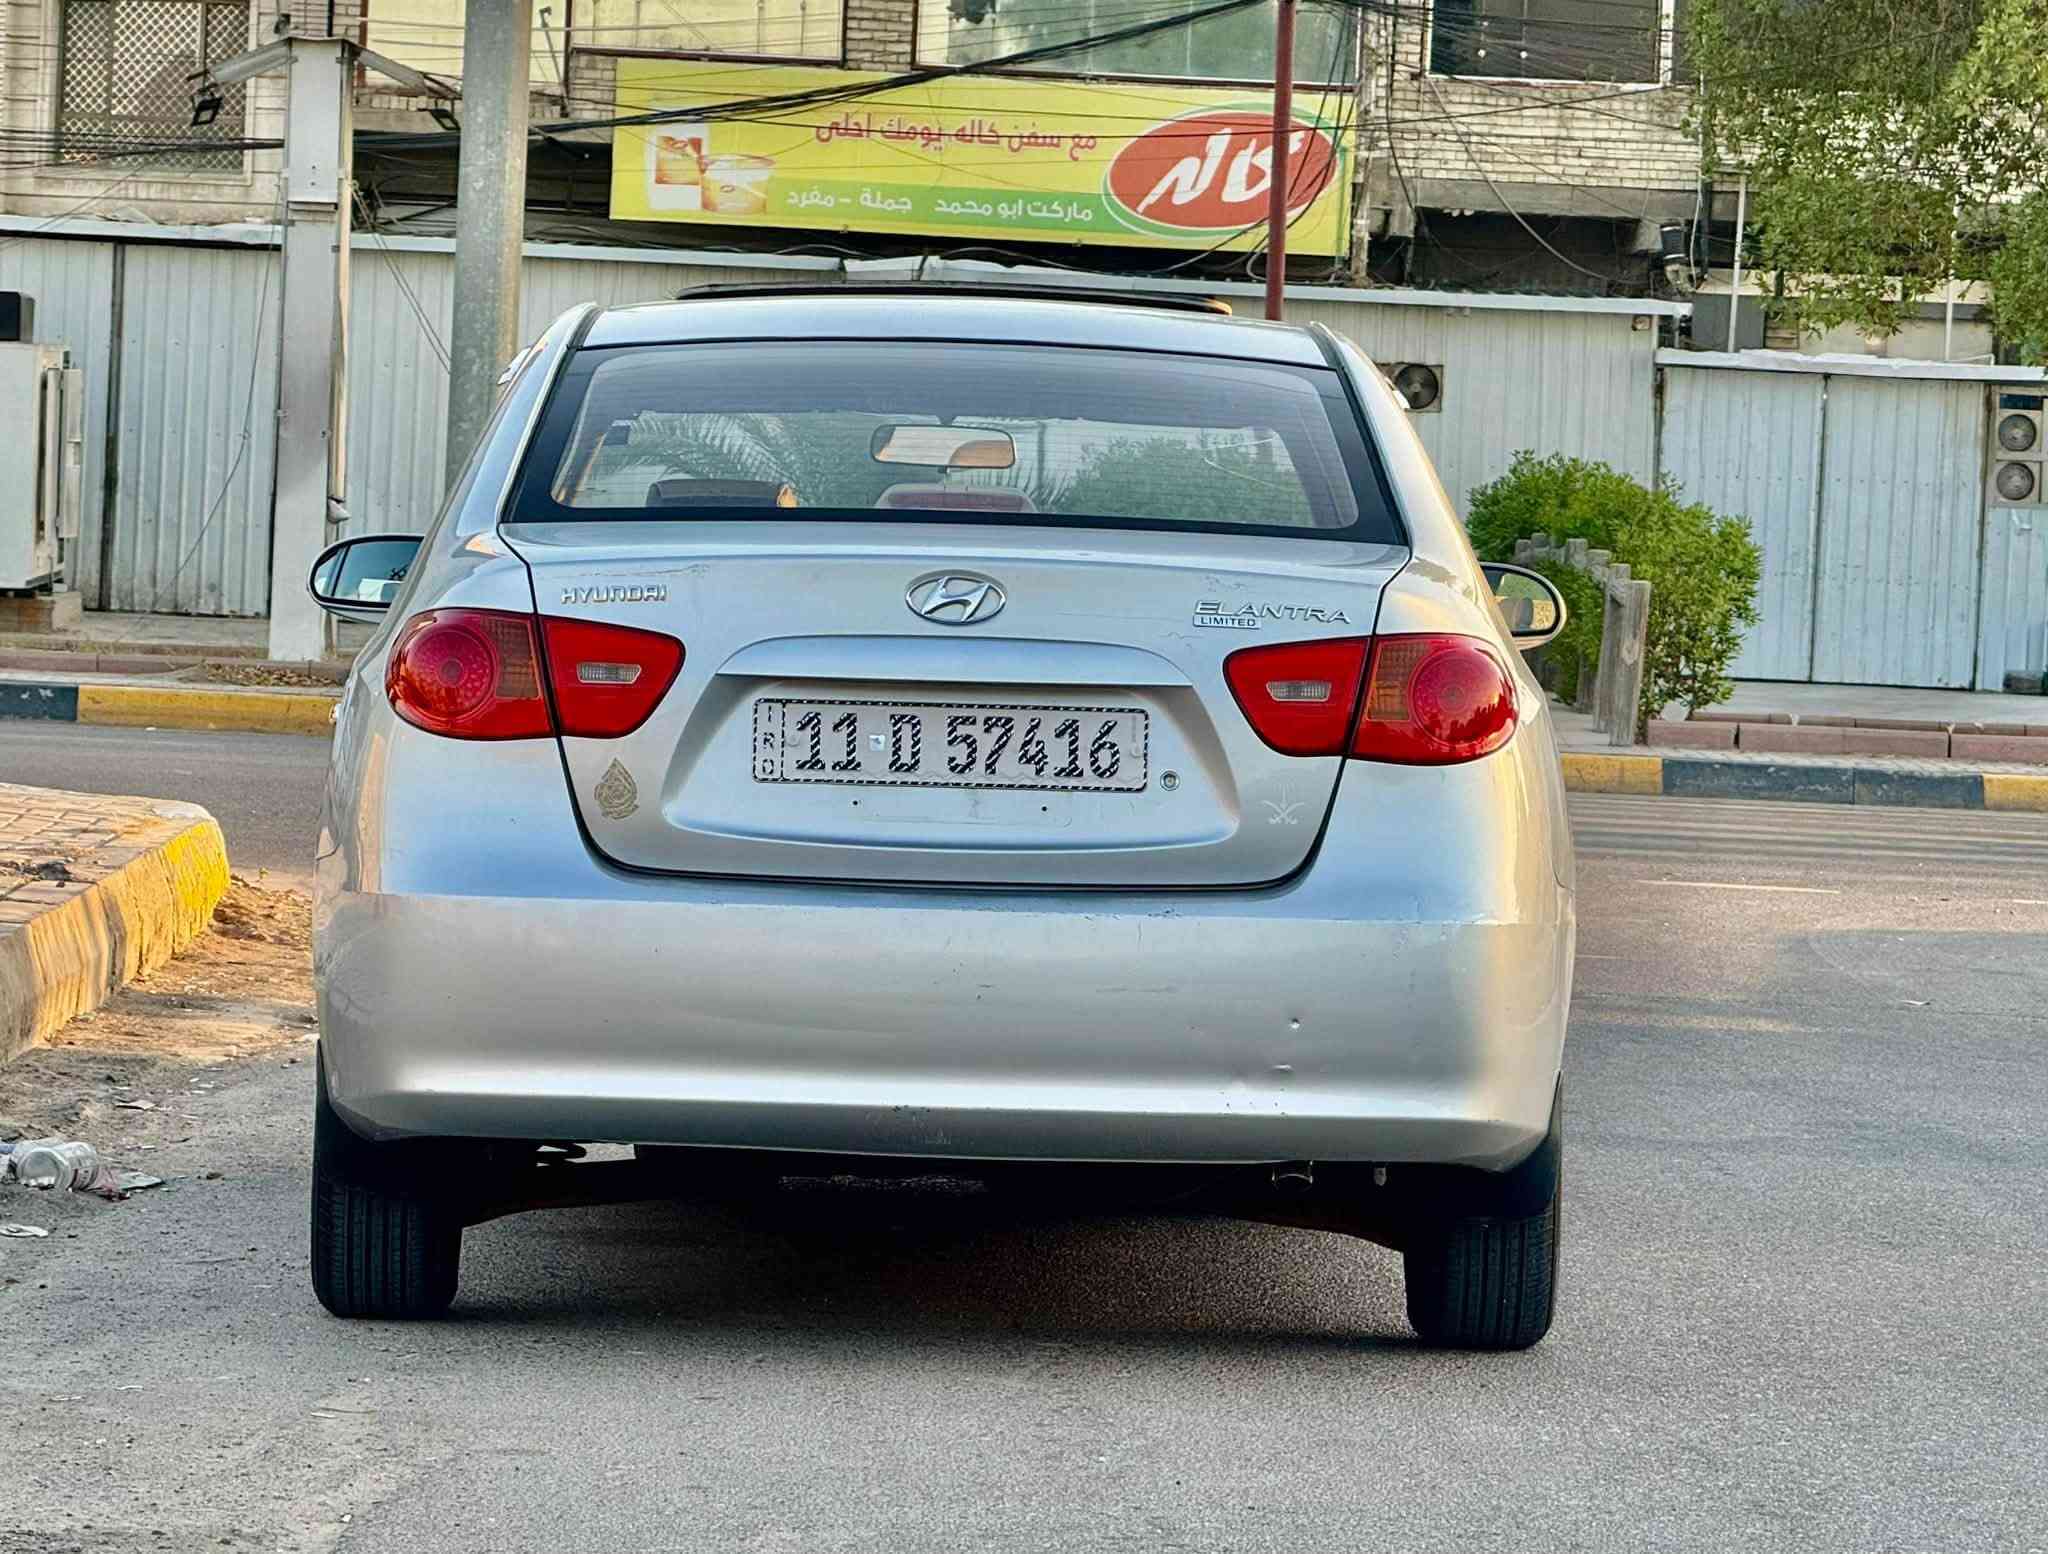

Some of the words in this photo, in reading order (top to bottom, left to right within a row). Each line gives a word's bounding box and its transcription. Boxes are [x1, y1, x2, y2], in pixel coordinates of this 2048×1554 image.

[880, 117, 942, 151] يومك
[954, 119, 1000, 145] كاله
[1069, 134, 1097, 161] مع
[787, 188, 835, 208] مفرد
[859, 188, 912, 212] جملة
[934, 200, 992, 216] محمد
[998, 199, 1023, 217] ابو
[1027, 201, 1093, 222] ماركت
[560, 585, 668, 604] HYUNDAI
[1194, 600, 1352, 625] ELANTRA
[1200, 616, 1257, 627] LIMITED
[796, 711, 861, 771] 11
[888, 714, 922, 773] D
[946, 715, 1121, 778] 57416
